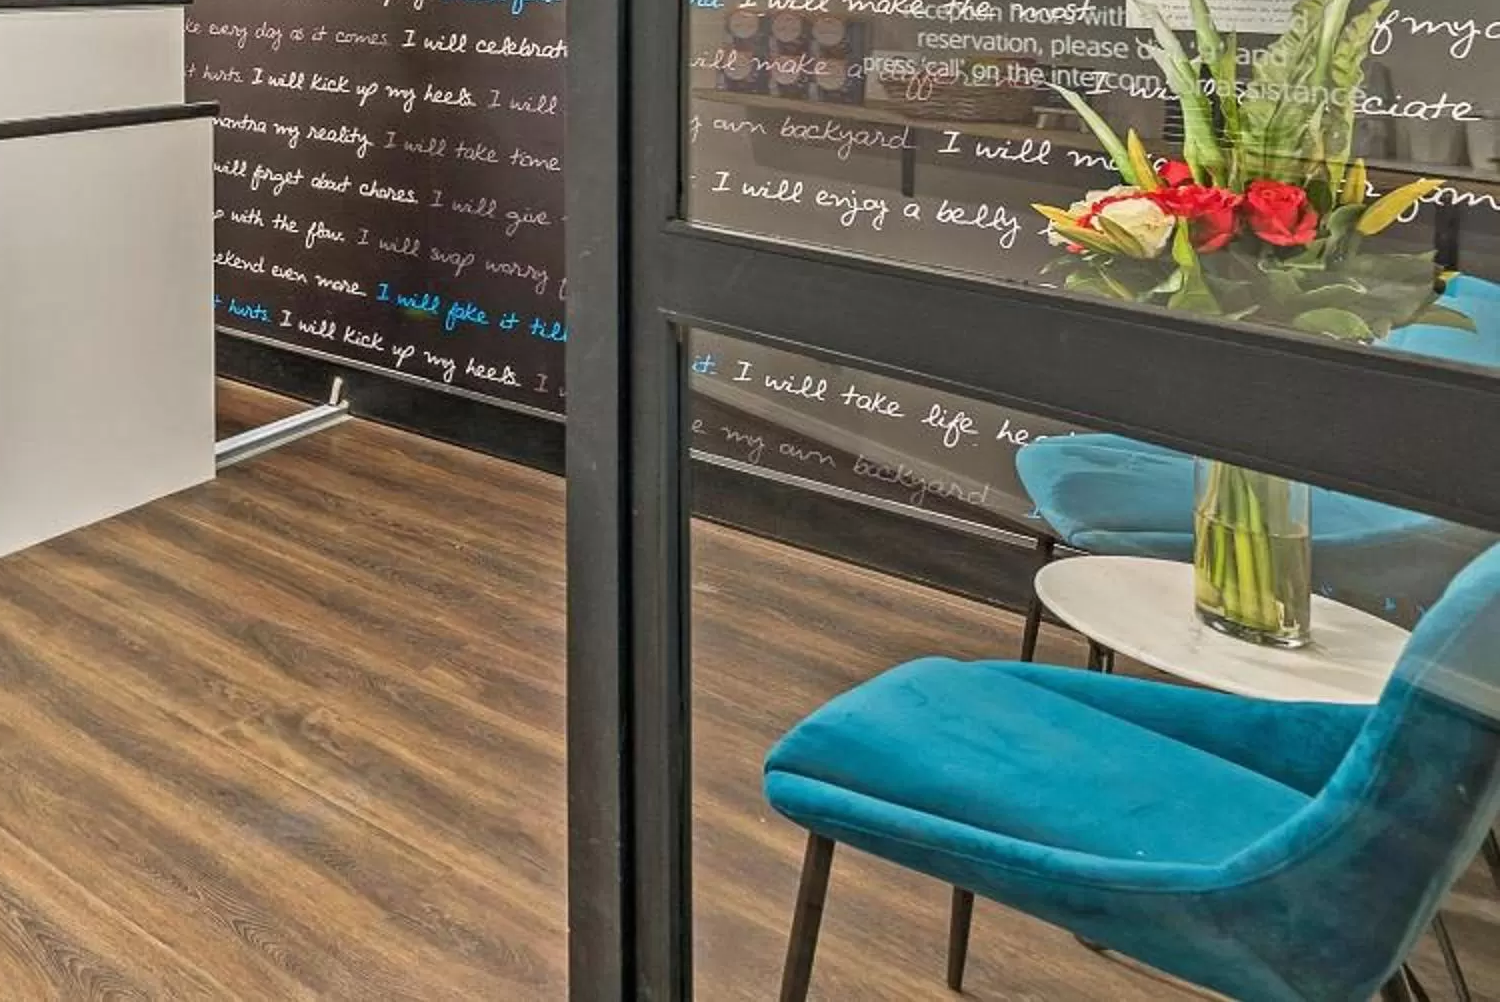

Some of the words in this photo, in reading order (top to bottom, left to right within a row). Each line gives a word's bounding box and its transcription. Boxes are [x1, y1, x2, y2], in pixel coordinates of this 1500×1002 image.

[209, 25, 248, 48] every
[254, 22, 283, 48] day
[917, 31, 1044, 55] reservation,
[1051, 34, 1129, 58] please
[1401, 17, 1482, 59] my
[750, 51, 830, 75] make
[847, 62, 863, 79] a
[863, 56, 915, 75] press
[972, 64, 1000, 82] on
[1007, 64, 1046, 83] the
[1086, 71, 1111, 95] I
[309, 71, 351, 94] kick
[355, 82, 379, 106] up
[385, 83, 417, 111] my
[275, 123, 301, 149] my
[455, 143, 499, 163] take
[509, 151, 562, 172] time
[713, 118, 768, 135] own
[937, 130, 960, 153] I
[975, 139, 1051, 166] will
[250, 162, 305, 196] forget
[310, 169, 352, 193] about
[504, 209, 553, 236] give
[712, 171, 730, 192] I
[742, 180, 803, 204] will
[816, 188, 889, 231] enjoy
[903, 202, 921, 220] a
[935, 199, 1021, 248] belly
[230, 206, 265, 228] with
[271, 214, 299, 234] the
[430, 246, 476, 278] swap
[485, 258, 549, 296] worry
[271, 262, 308, 285] even
[446, 295, 489, 330] fake
[500, 311, 521, 330] it
[343, 324, 385, 352] kick
[392, 345, 416, 368] up
[423, 350, 457, 384] my
[732, 360, 752, 382] I
[764, 375, 827, 401] will
[840, 388, 905, 417] take
[720, 425, 766, 465] my
[779, 439, 836, 469] own
